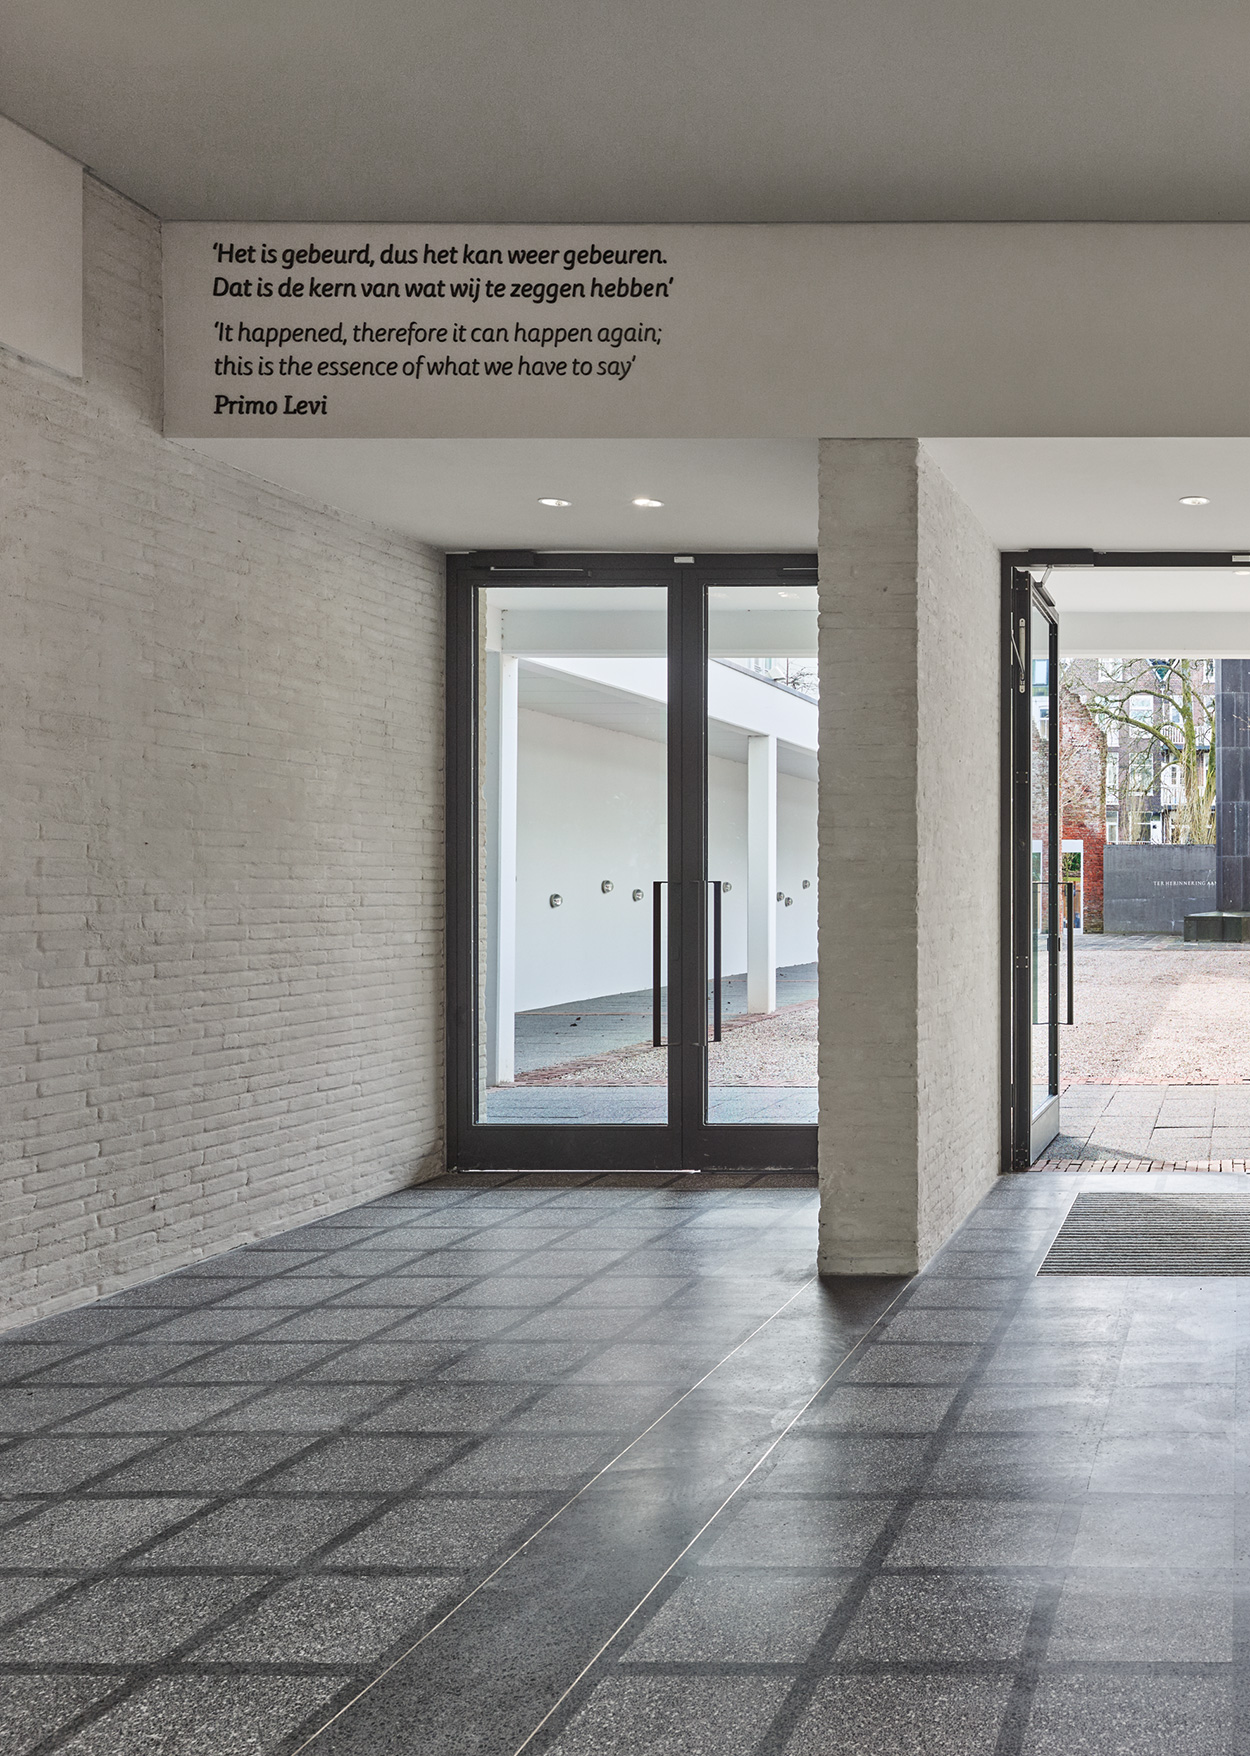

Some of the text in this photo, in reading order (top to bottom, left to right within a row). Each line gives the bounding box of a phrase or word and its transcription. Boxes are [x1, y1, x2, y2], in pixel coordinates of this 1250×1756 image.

[261, 243, 277, 263] is
[282, 243, 375, 269] gebeurd,
[380, 244, 418, 264] dus
[423, 244, 458, 264] het
[463, 244, 503, 264] kan
[508, 250, 560, 264] weer
[563, 244, 667, 270] gebeuren.
[213, 277, 253, 297] Dat
[257, 277, 273, 297] is
[278, 277, 304, 297] de
[309, 277, 357, 297] kern
[361, 283, 400, 297] van
[405, 280, 446, 298] wat
[450, 278, 481, 303] wij
[485, 280, 506, 298] te
[510, 283, 585, 304] zeggen
[238, 321, 347, 347] happened,
[353, 321, 448, 346] therefore
[453, 323, 467, 342] it
[471, 328, 509, 342] can
[514, 322, 592, 347] happen
[597, 322, 662, 348] again;
[214, 355, 253, 376] this
[258, 356, 274, 376] is
[279, 355, 313, 376] the
[317, 361, 398, 376] essence
[402, 355, 426, 379] of
[427, 355, 480, 376] what
[484, 361, 513, 376] we
[518, 355, 567, 376] have
[572, 358, 592, 376] to
[213, 395, 327, 415] Primo Levi
